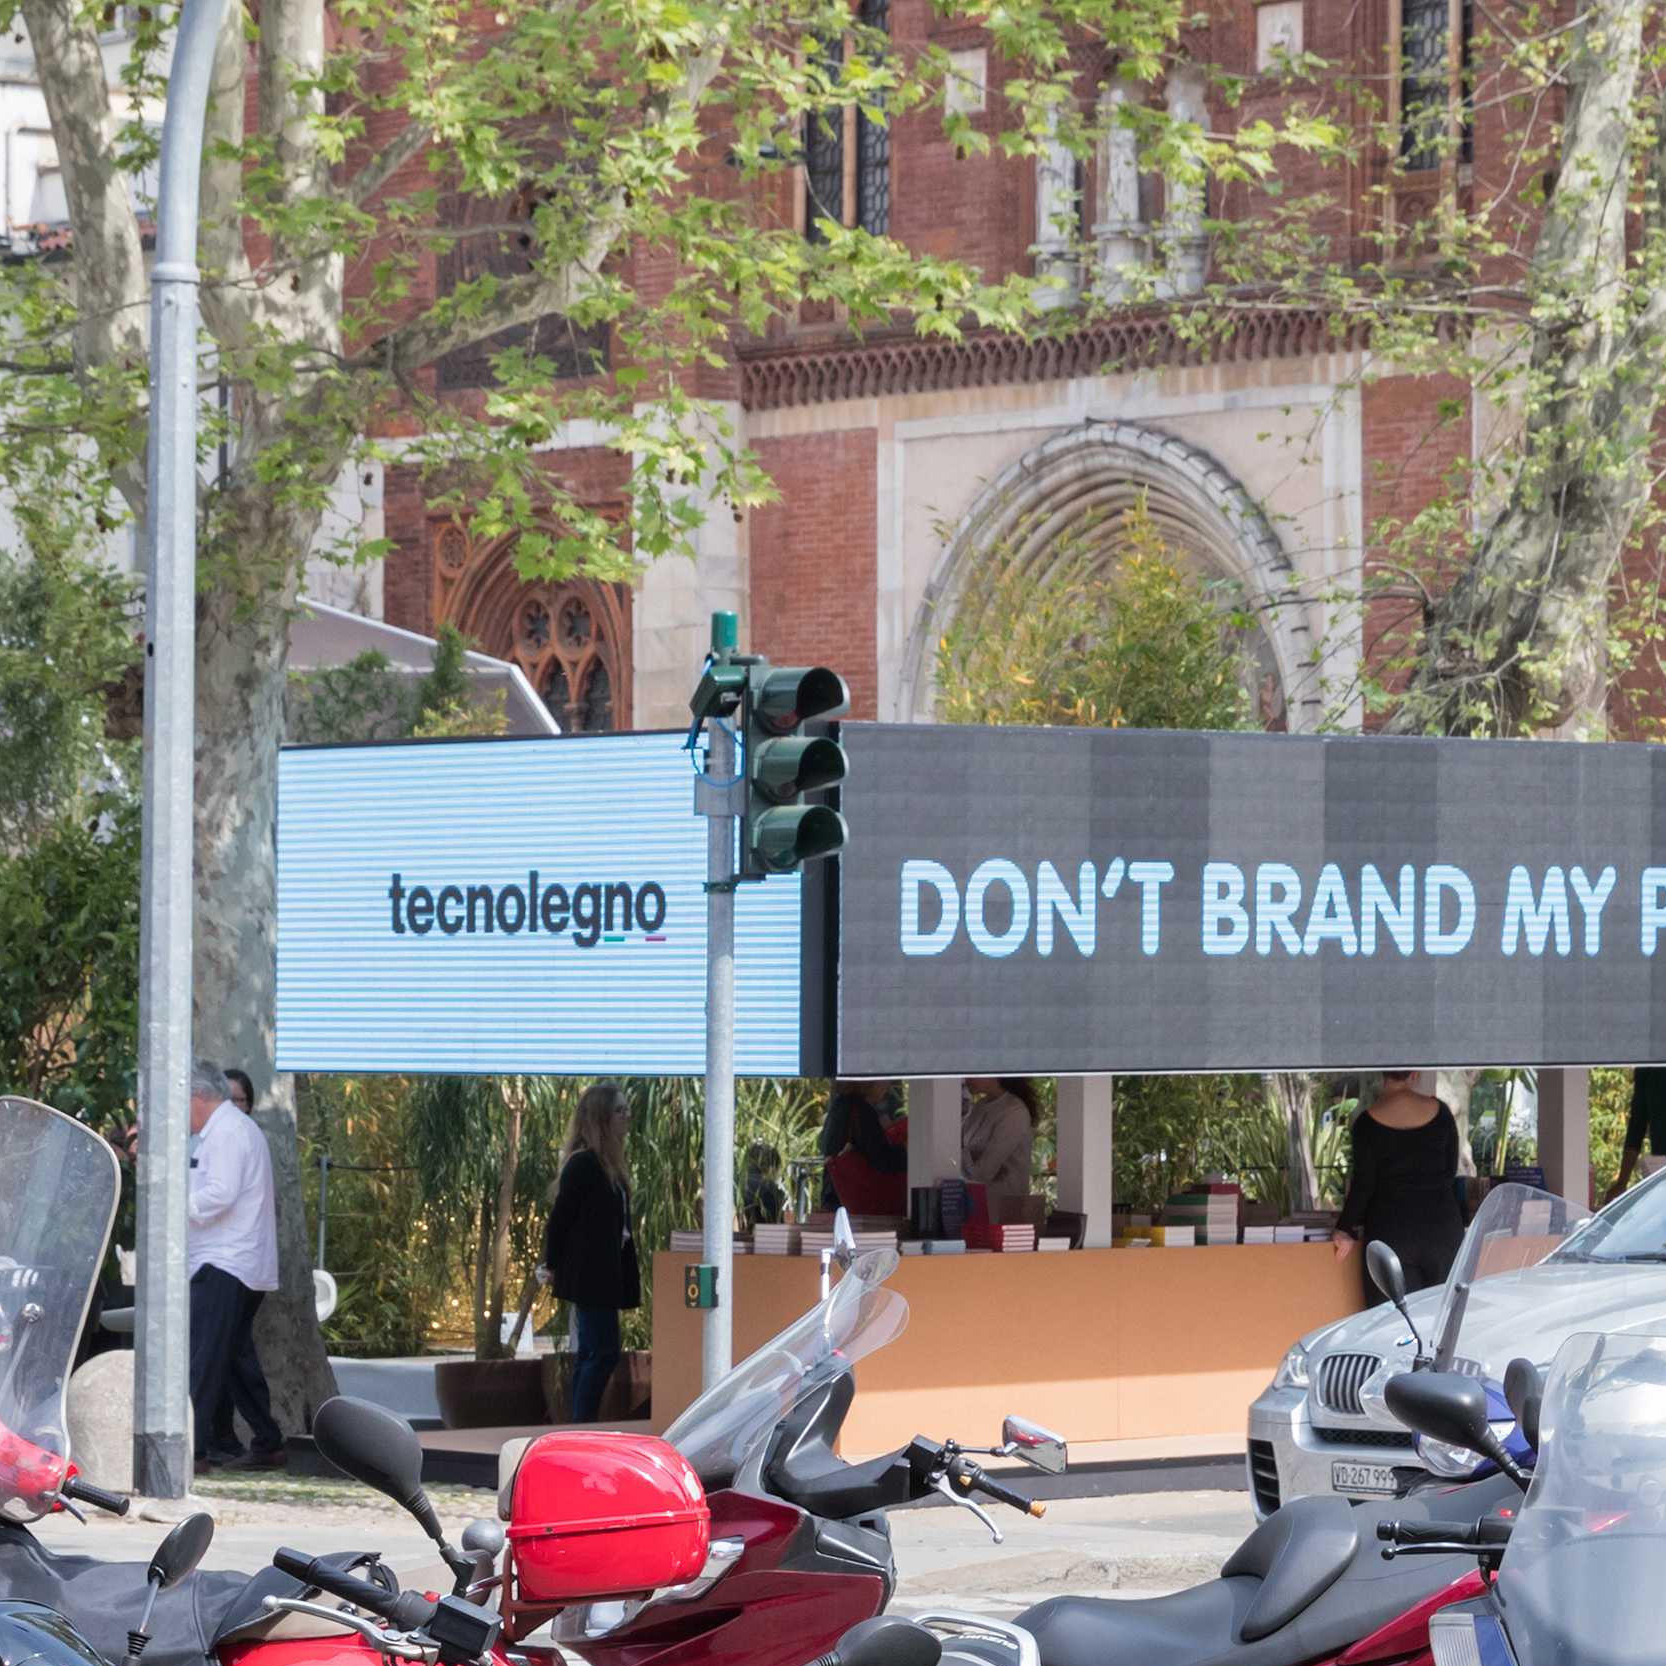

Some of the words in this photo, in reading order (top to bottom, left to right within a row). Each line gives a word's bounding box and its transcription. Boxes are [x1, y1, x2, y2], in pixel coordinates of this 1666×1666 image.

[389, 871, 667, 947] tecnolegno
[900, 859, 1172, 957] DON'T
[1202, 862, 1476, 957] BRAND
[1501, 865, 1617, 957] MY
